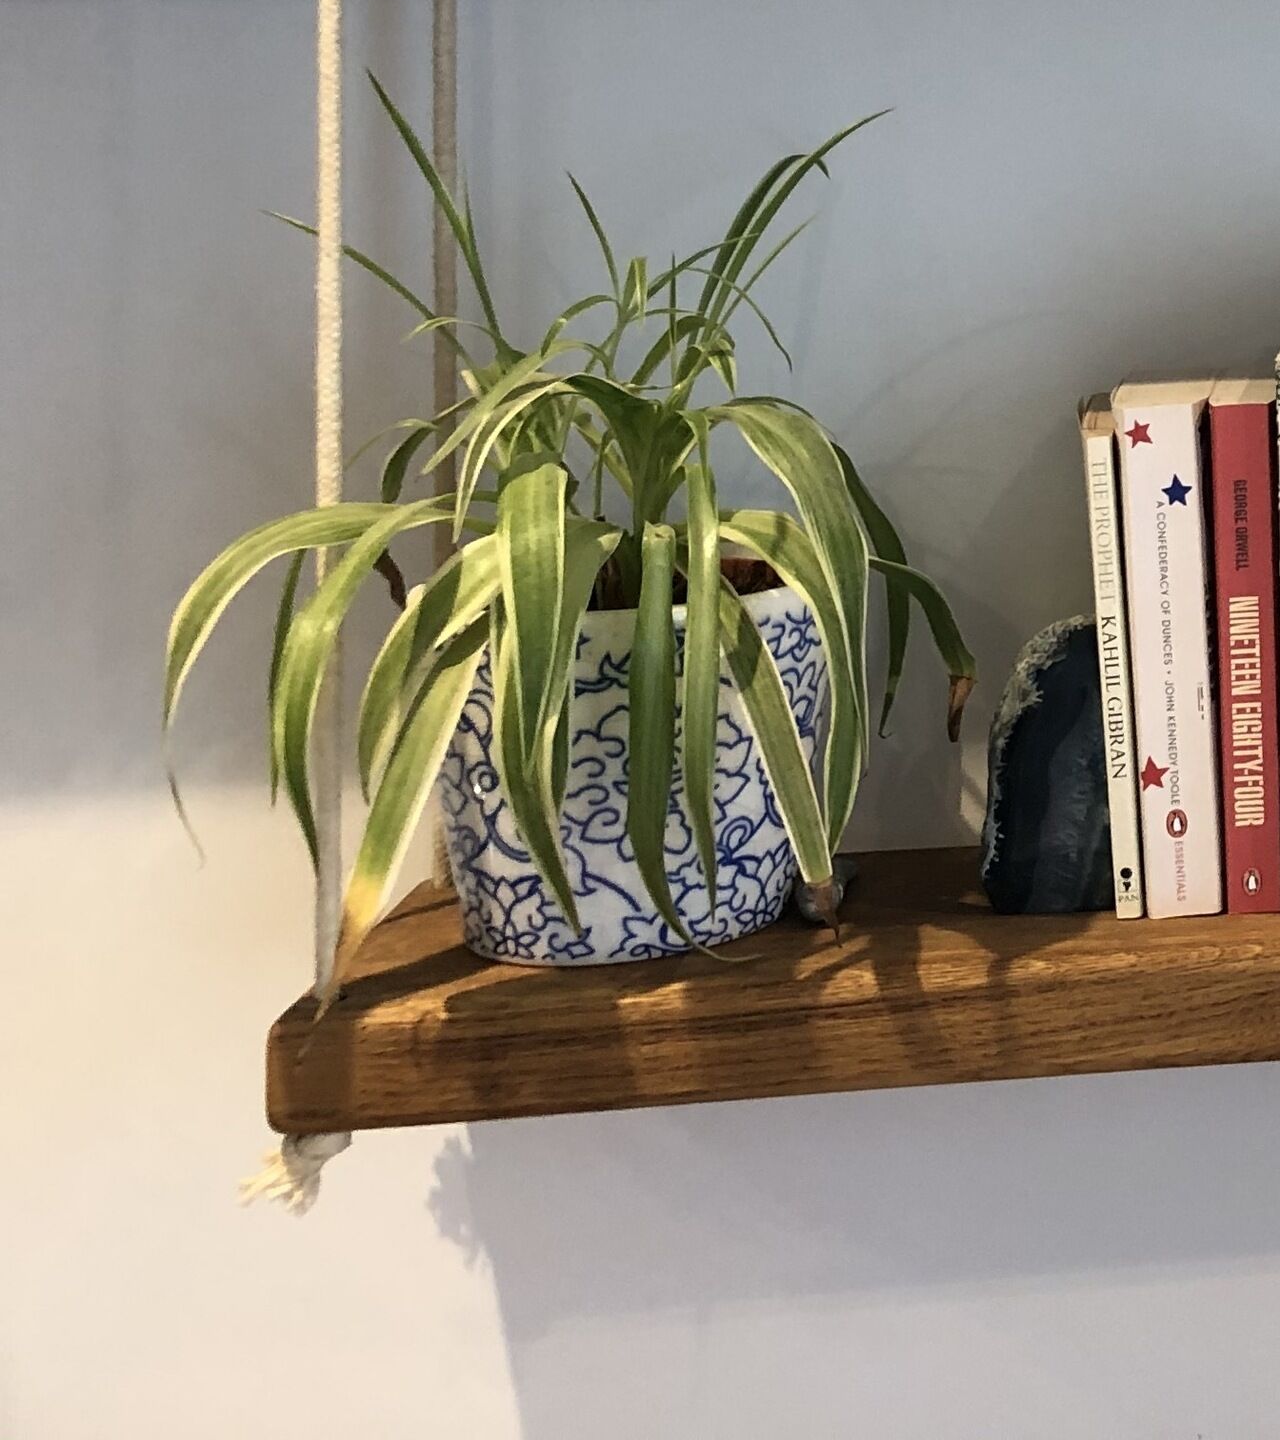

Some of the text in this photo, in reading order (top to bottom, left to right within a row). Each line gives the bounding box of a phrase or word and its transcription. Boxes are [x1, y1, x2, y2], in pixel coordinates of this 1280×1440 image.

[1092, 458, 1127, 779] THE PROPHET KAHLIL GIBRAN
[1234, 479, 1249, 571] GEORGE ORWELL
[1156, 500, 1180, 806] A CONFEDERACY OF DUNCES JOHN KENNEDY TOOLE
[1229, 596, 1265, 827] NINETEEN EIGHTY-FOUR
[1174, 840, 1187, 902] ESSENTIALS
